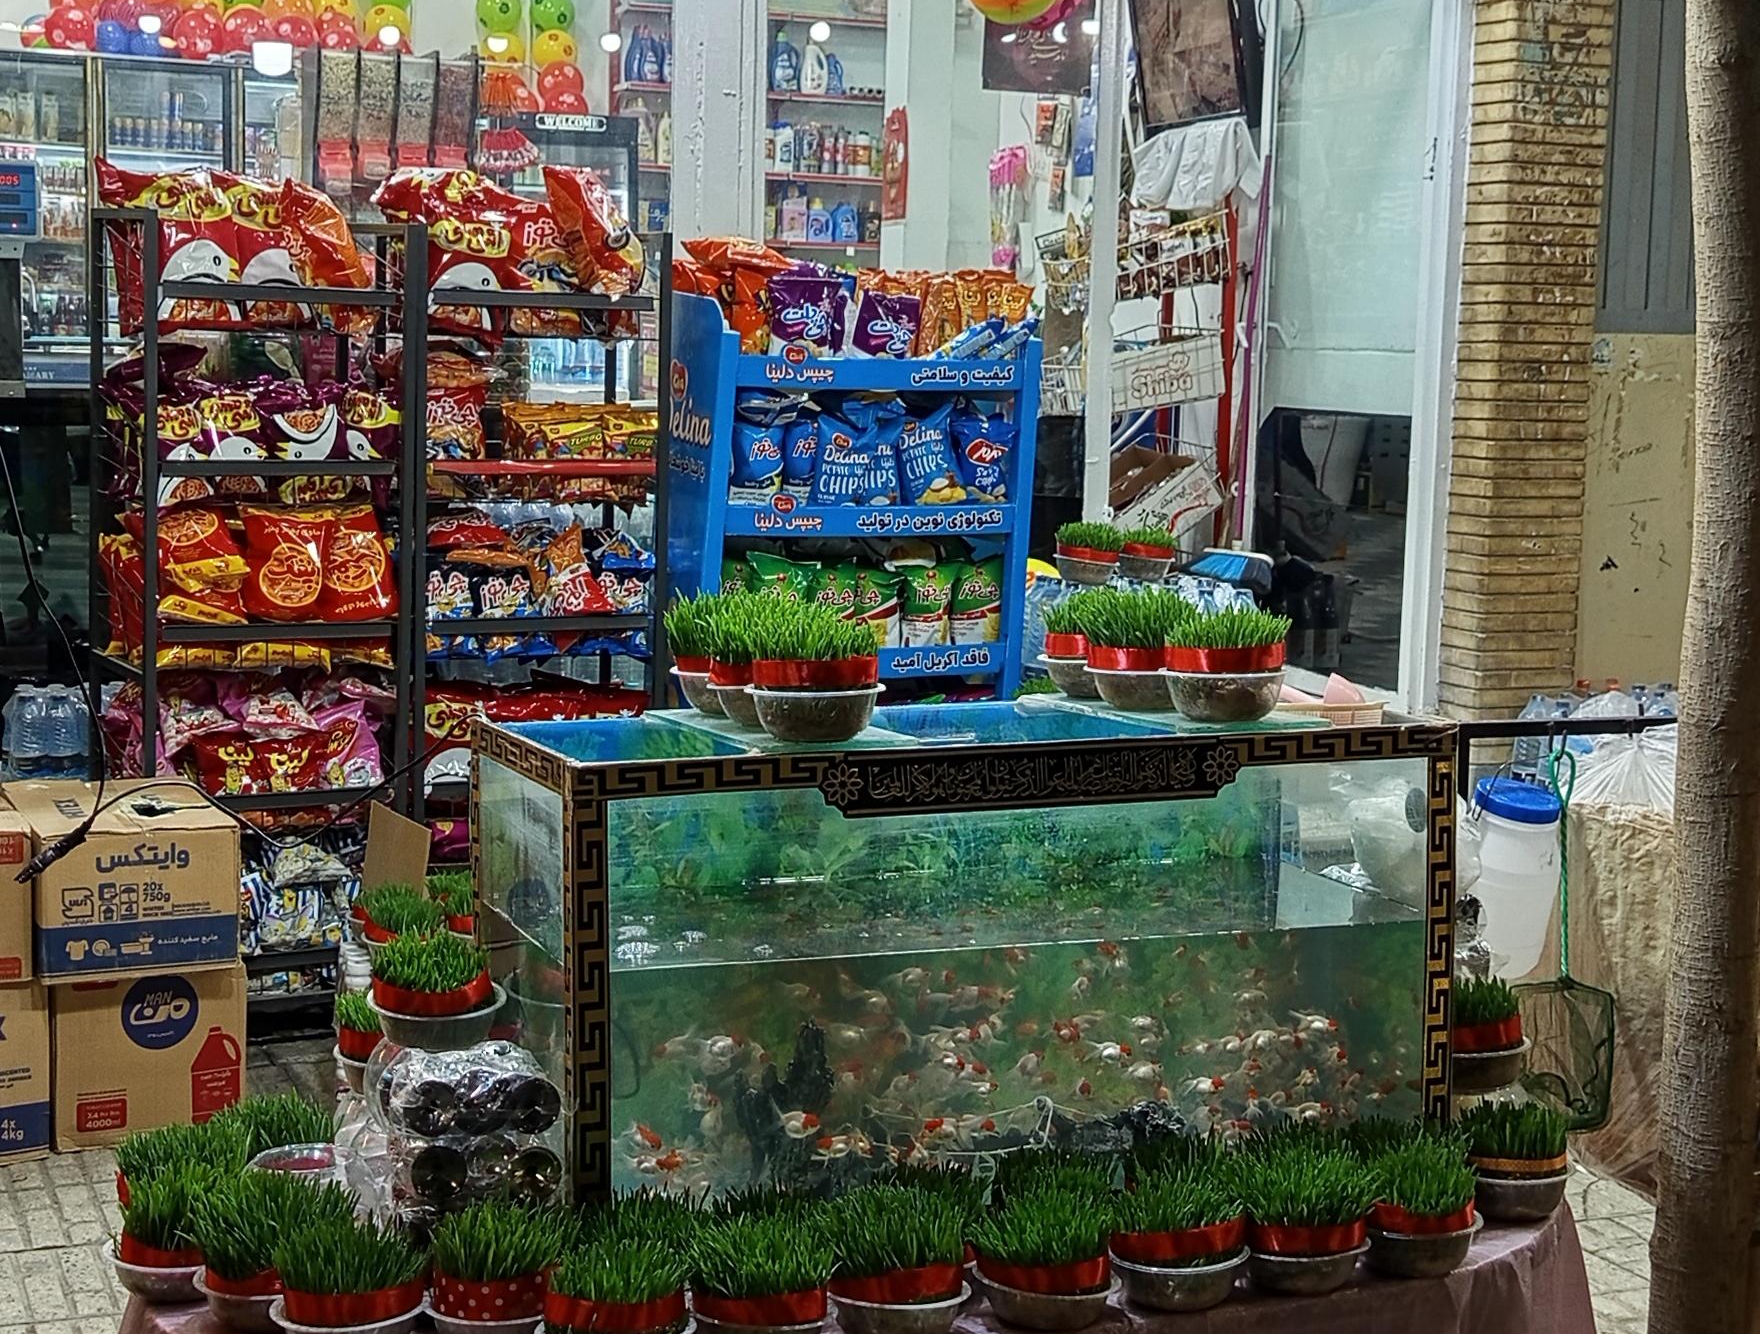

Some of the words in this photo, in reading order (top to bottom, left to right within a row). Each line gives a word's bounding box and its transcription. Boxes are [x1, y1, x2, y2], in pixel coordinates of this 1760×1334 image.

[542, 115, 600, 130] WELCOME
[765, 363, 795, 384] دلینا
[796, 367, 835, 384] چیپس
[911, 367, 958, 388] سلامتی
[959, 372, 968, 386] و
[971, 365, 1014, 387] کیفیت
[1131, 369, 1194, 400] Shiba
[569, 433, 603, 447] TURBO
[823, 444, 870, 465] Delina
[906, 453, 948, 480] CHIPS
[819, 474, 866, 496] CHIPS
[754, 511, 783, 532] دلینا
[785, 515, 823, 532] چیپس
[856, 512, 894, 533] تولید
[894, 516, 911, 532] در
[912, 511, 944, 532] نوین
[947, 509, 1003, 532] تکنولوژی
[891, 653, 921, 672] آمید
[922, 651, 959, 671] آکریل
[961, 648, 990, 668] فاقد
[95, 842, 190, 873] وایتکس
[142, 882, 164, 893] 20x
[142, 892, 171, 904] 750g
[157, 936, 179, 946] کننده
[181, 935, 201, 946] سفید
[201, 933, 219, 945] مایع
[143, 990, 173, 1008] MAN
[1, 1118, 16, 1129] 4x
[1, 1129, 24, 1141] 4kg
